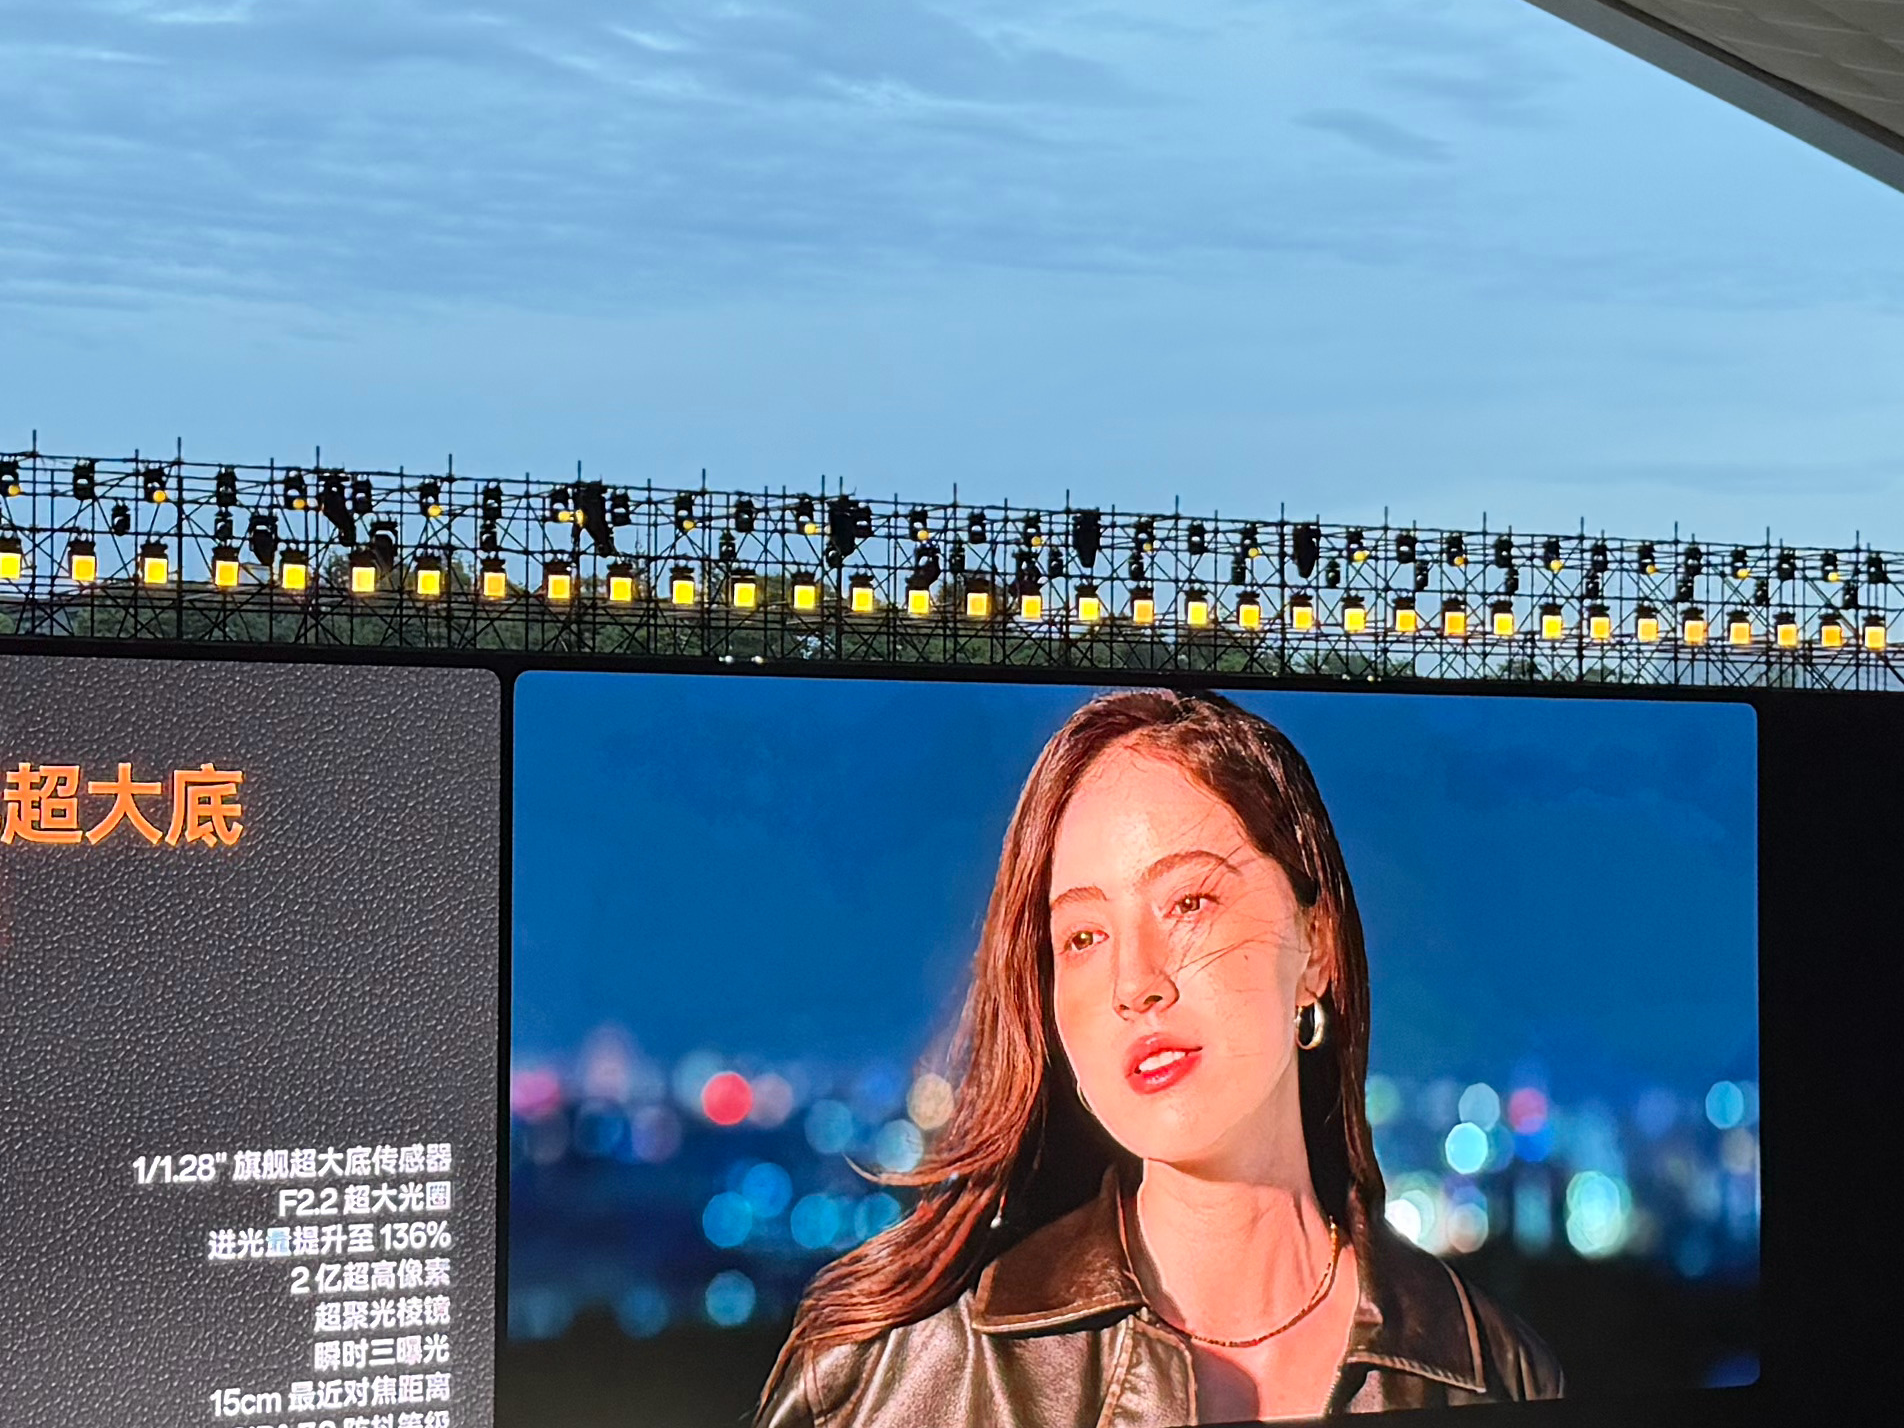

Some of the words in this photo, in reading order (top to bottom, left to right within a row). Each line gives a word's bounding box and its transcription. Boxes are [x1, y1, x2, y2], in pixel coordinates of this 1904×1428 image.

[233, 1143, 451, 1181] 旗舰超大底传感器
[278, 1188, 338, 1217] F2.2
[344, 1181, 451, 1213] 超大光圈
[208, 1224, 374, 1260] 进光量提升至
[380, 1221, 451, 1251] 136%
[291, 1267, 310, 1293] 2
[315, 1258, 450, 1292] 亿超高像素
[315, 1295, 451, 1332] 超聚光棱镜
[314, 1334, 449, 1371] 瞬时三曝光
[210, 1388, 282, 1417] 15cm
[288, 1372, 451, 1412] 最近对焦距离
